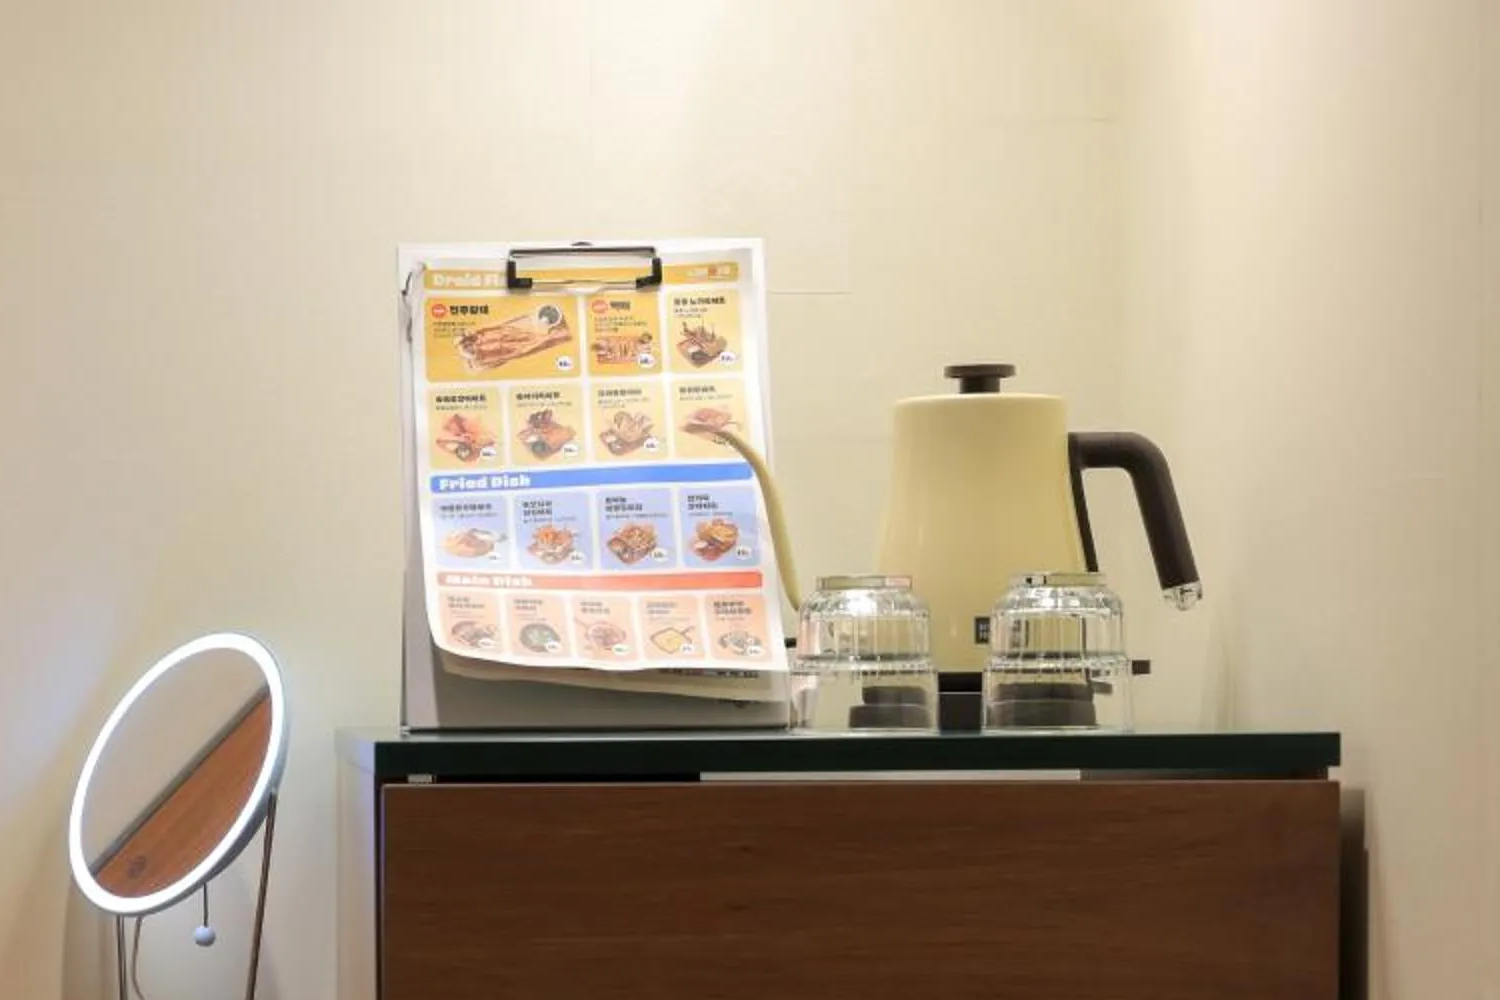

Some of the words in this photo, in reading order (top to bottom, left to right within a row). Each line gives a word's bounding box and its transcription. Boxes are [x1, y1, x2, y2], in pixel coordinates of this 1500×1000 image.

[439, 476, 488, 490] Fried
[491, 474, 531, 488] Dish
[493, 576, 533, 587] Dish
